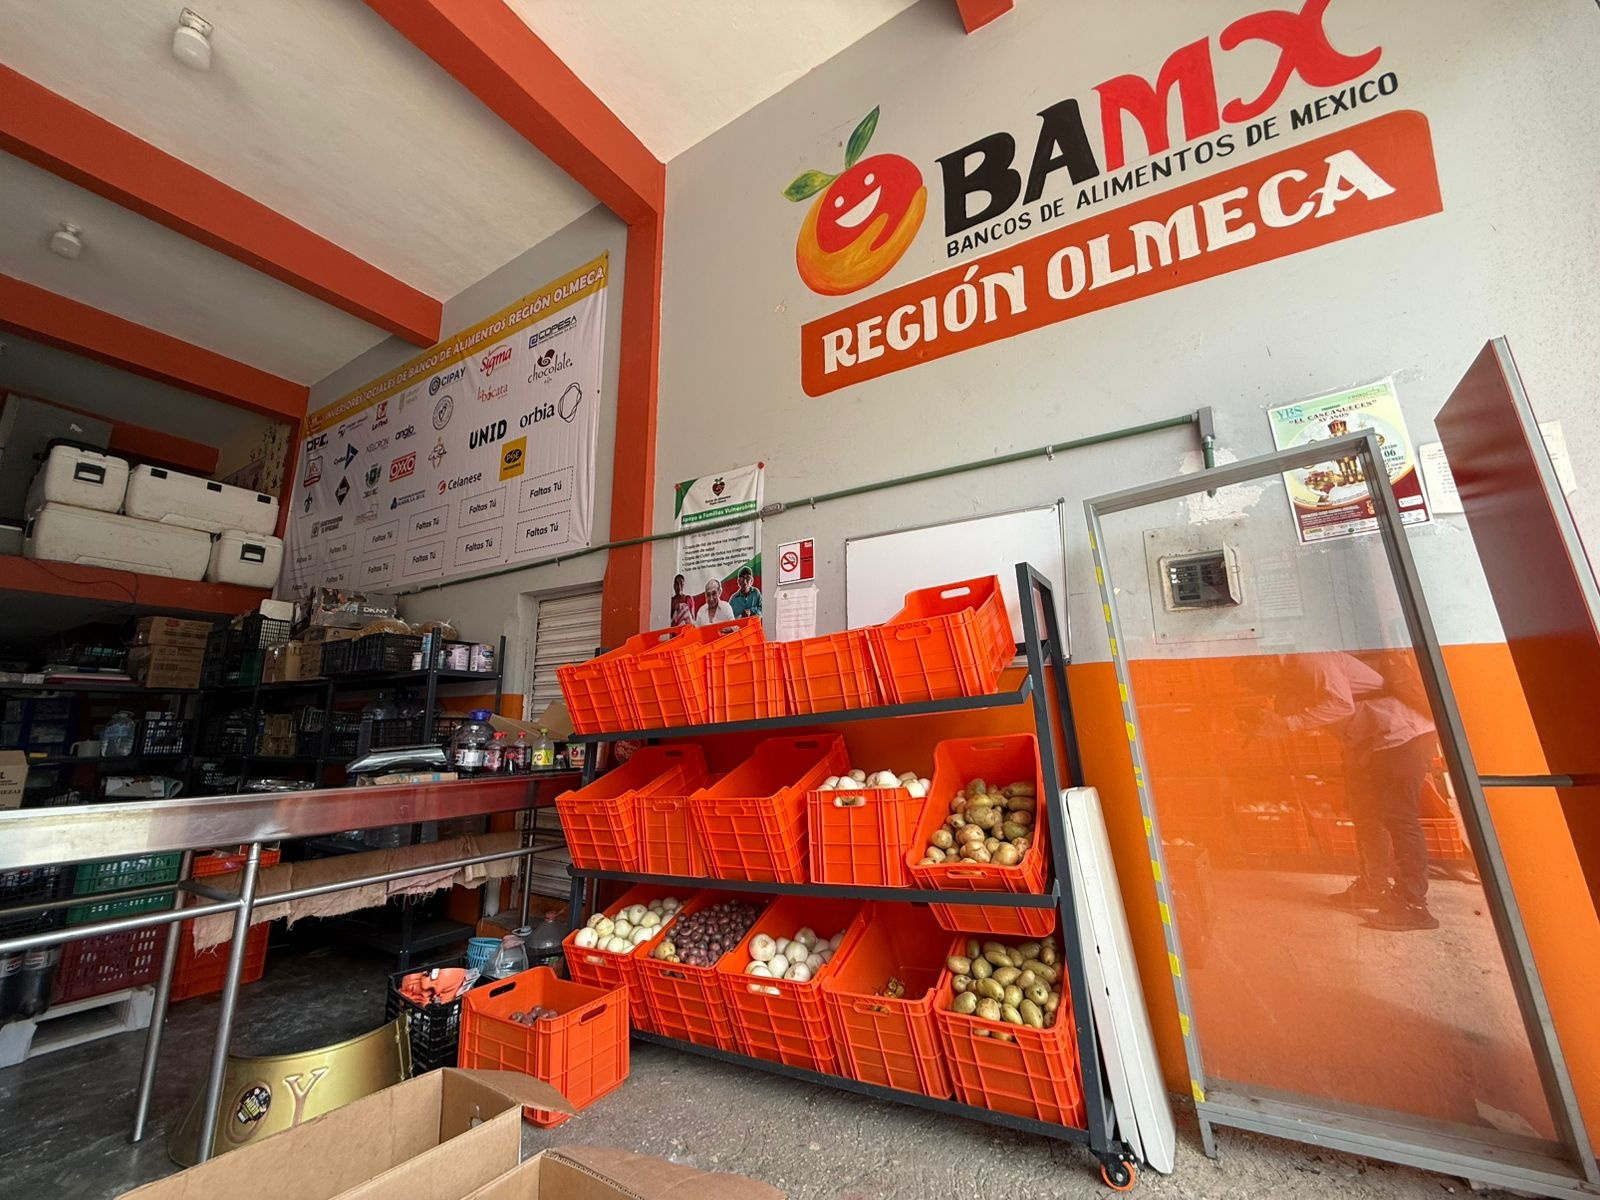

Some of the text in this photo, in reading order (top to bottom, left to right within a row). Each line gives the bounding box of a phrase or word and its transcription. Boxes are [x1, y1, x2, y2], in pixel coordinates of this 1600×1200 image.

[935, 0, 1383, 238] BAMX
[946, 71, 1399, 258] BANCOS DE ALIMENTOS DE MEXICO
[821, 148, 1397, 375] REGIÓN OLMECA
[395, 373, 407, 383] DE
[408, 355, 438, 375] BANCO
[440, 348, 451, 360] DE
[453, 318, 507, 354] ALIMENTOS
[508, 296, 551, 326] REGIÓN
[553, 265, 604, 302] OLMECA
[538, 315, 578, 340] COPESA
[480, 347, 512, 376] Sigma
[441, 367, 466, 387] CIPAY
[520, 403, 555, 428] orbia
[395, 424, 415, 440] anglo
[469, 419, 507, 449] UNID
[1384, 449, 1397, 457] 06
[390, 456, 416, 478] OXXO
[448, 472, 482, 491] Celanese
[530, 480, 562, 498] Faltas Tú
[469, 499, 497, 514] Faltas Tú
[702, 510, 724, 519] Familias
[724, 502, 756, 514] Vulnerables
[416, 516, 439, 531] Faltas Tú
[526, 521, 559, 538] Faltas Tú
[372, 534, 386, 543] Faltas
[465, 537, 493, 552] Faltas Tú
[412, 551, 436, 564] Faltas Tú
[368, 565, 382, 574] Faltas
[363, 606, 389, 614] DKNY
